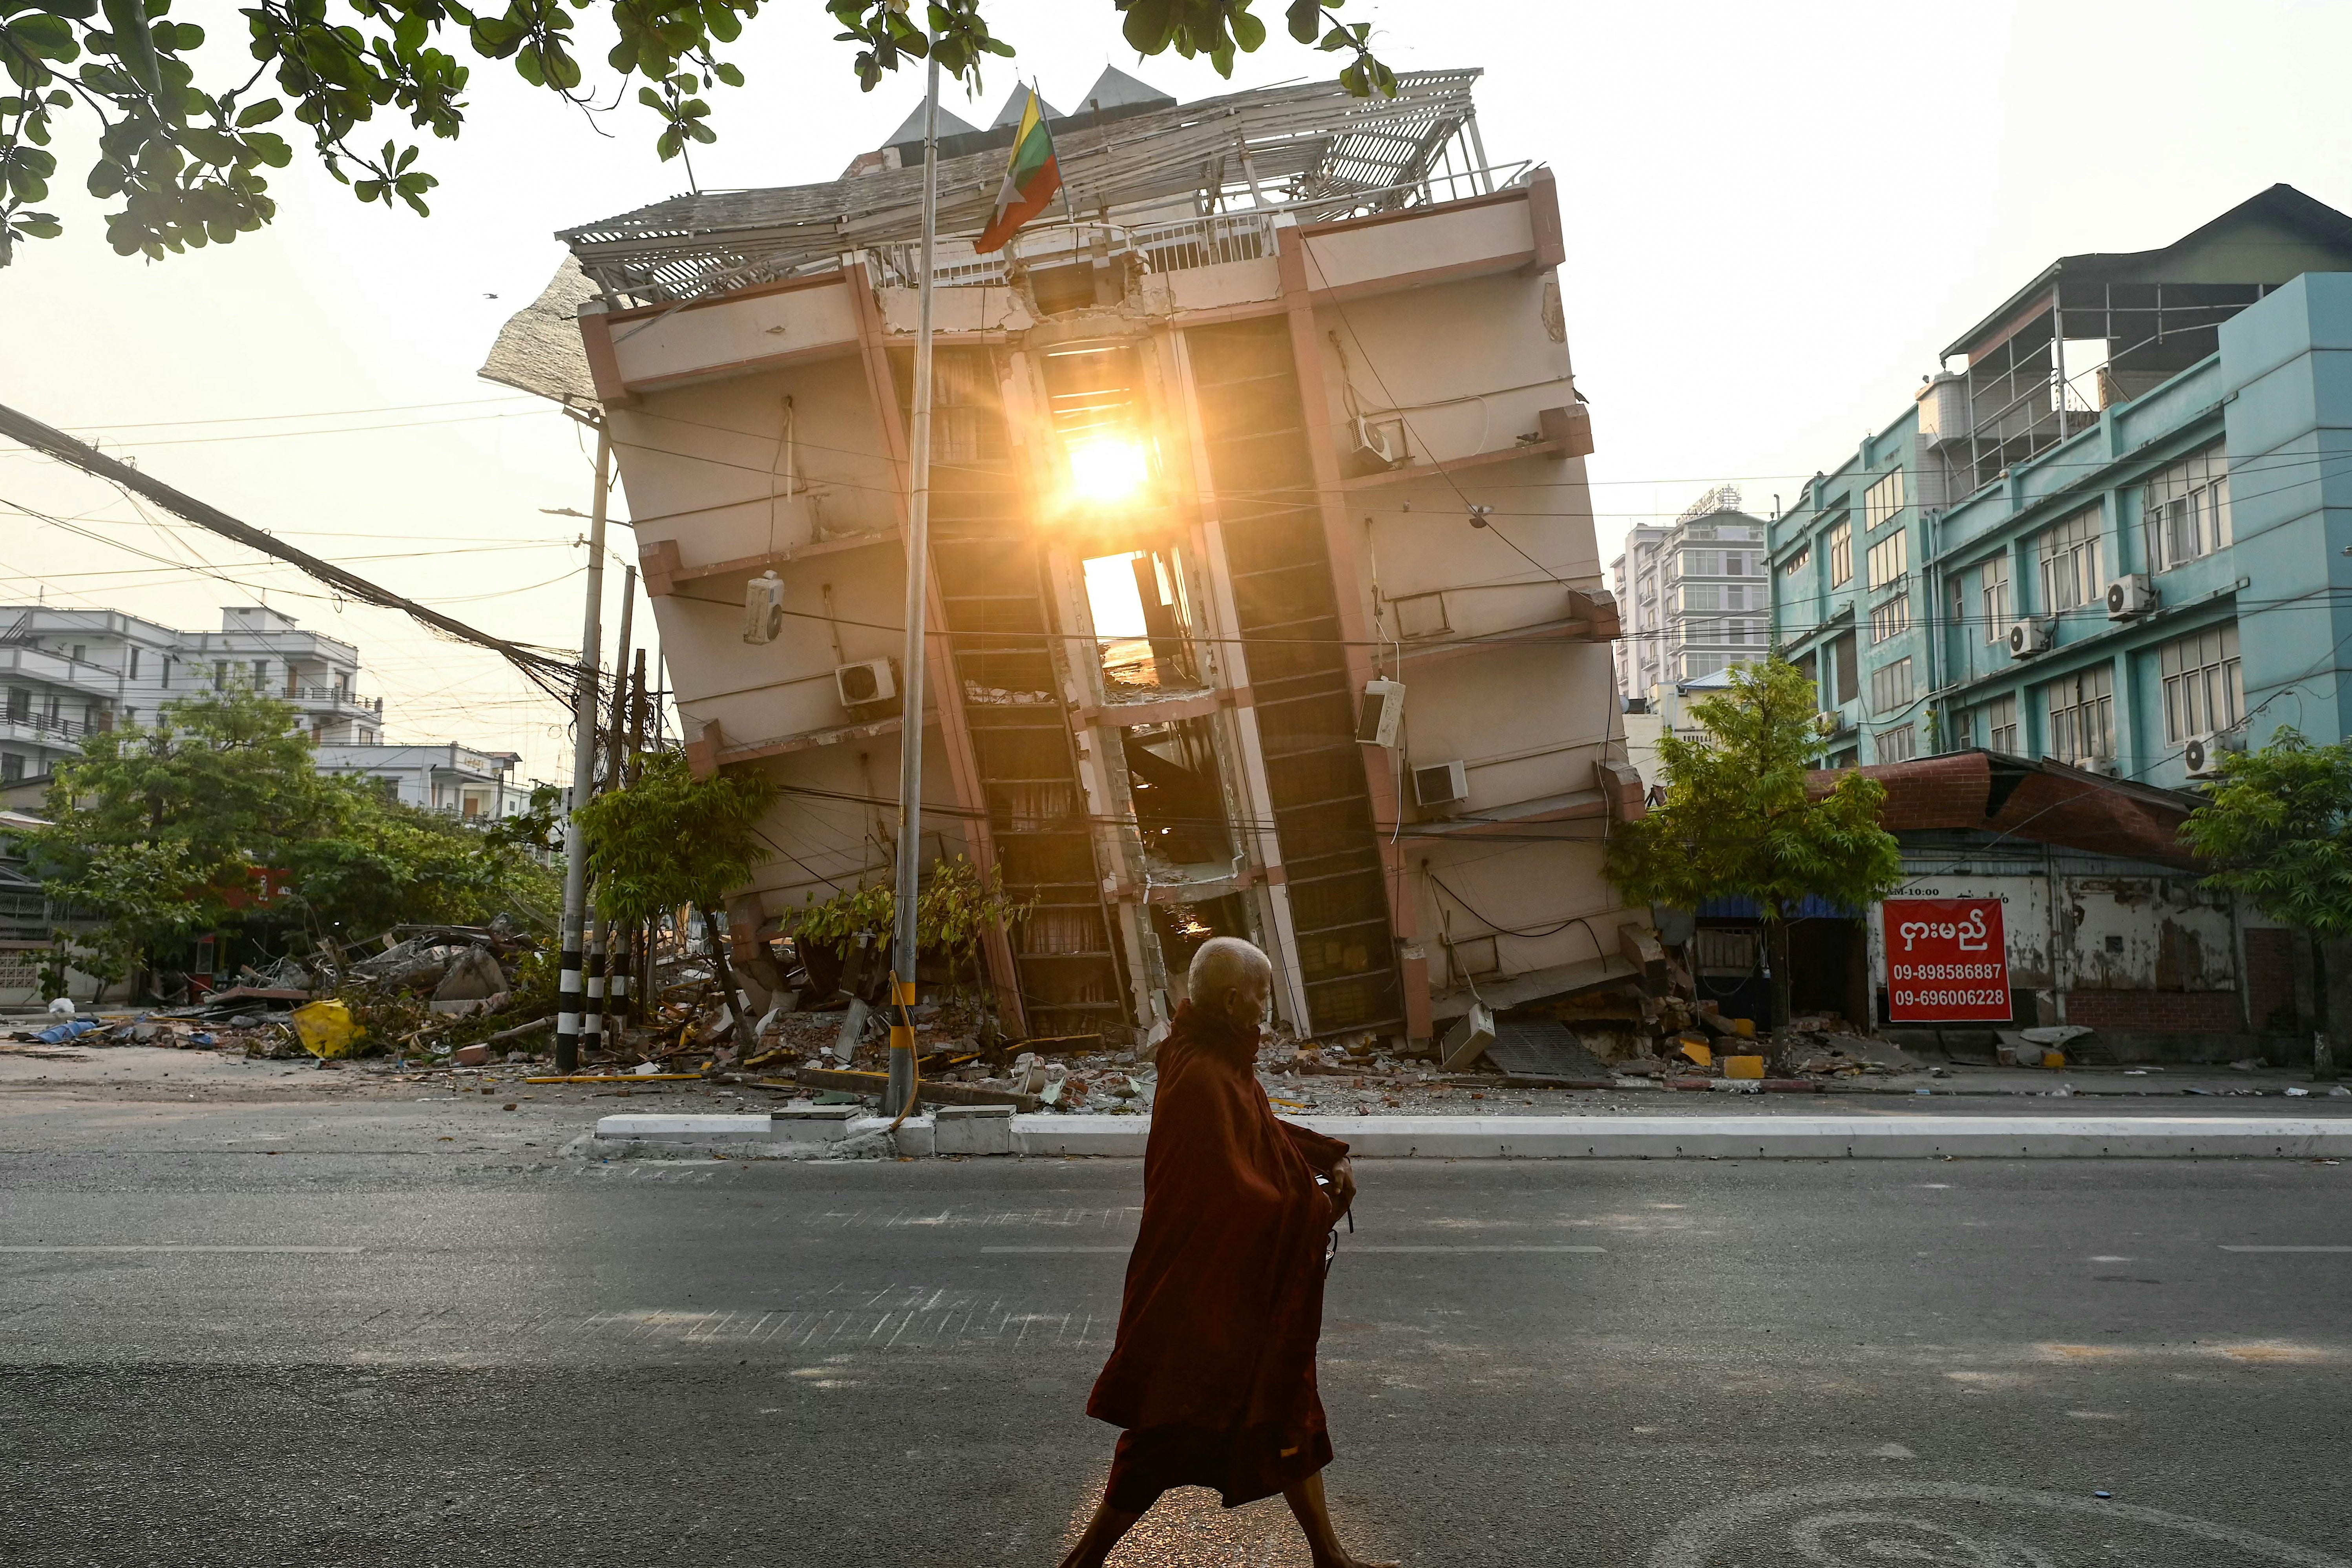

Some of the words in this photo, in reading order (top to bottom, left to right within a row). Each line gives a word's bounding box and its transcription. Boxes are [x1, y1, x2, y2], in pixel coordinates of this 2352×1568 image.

[1900, 909, 1988, 951] ငှားမည်
[1894, 964, 2002, 980] 09-898586887
[1895, 989, 2005, 1006] 09-696006228
